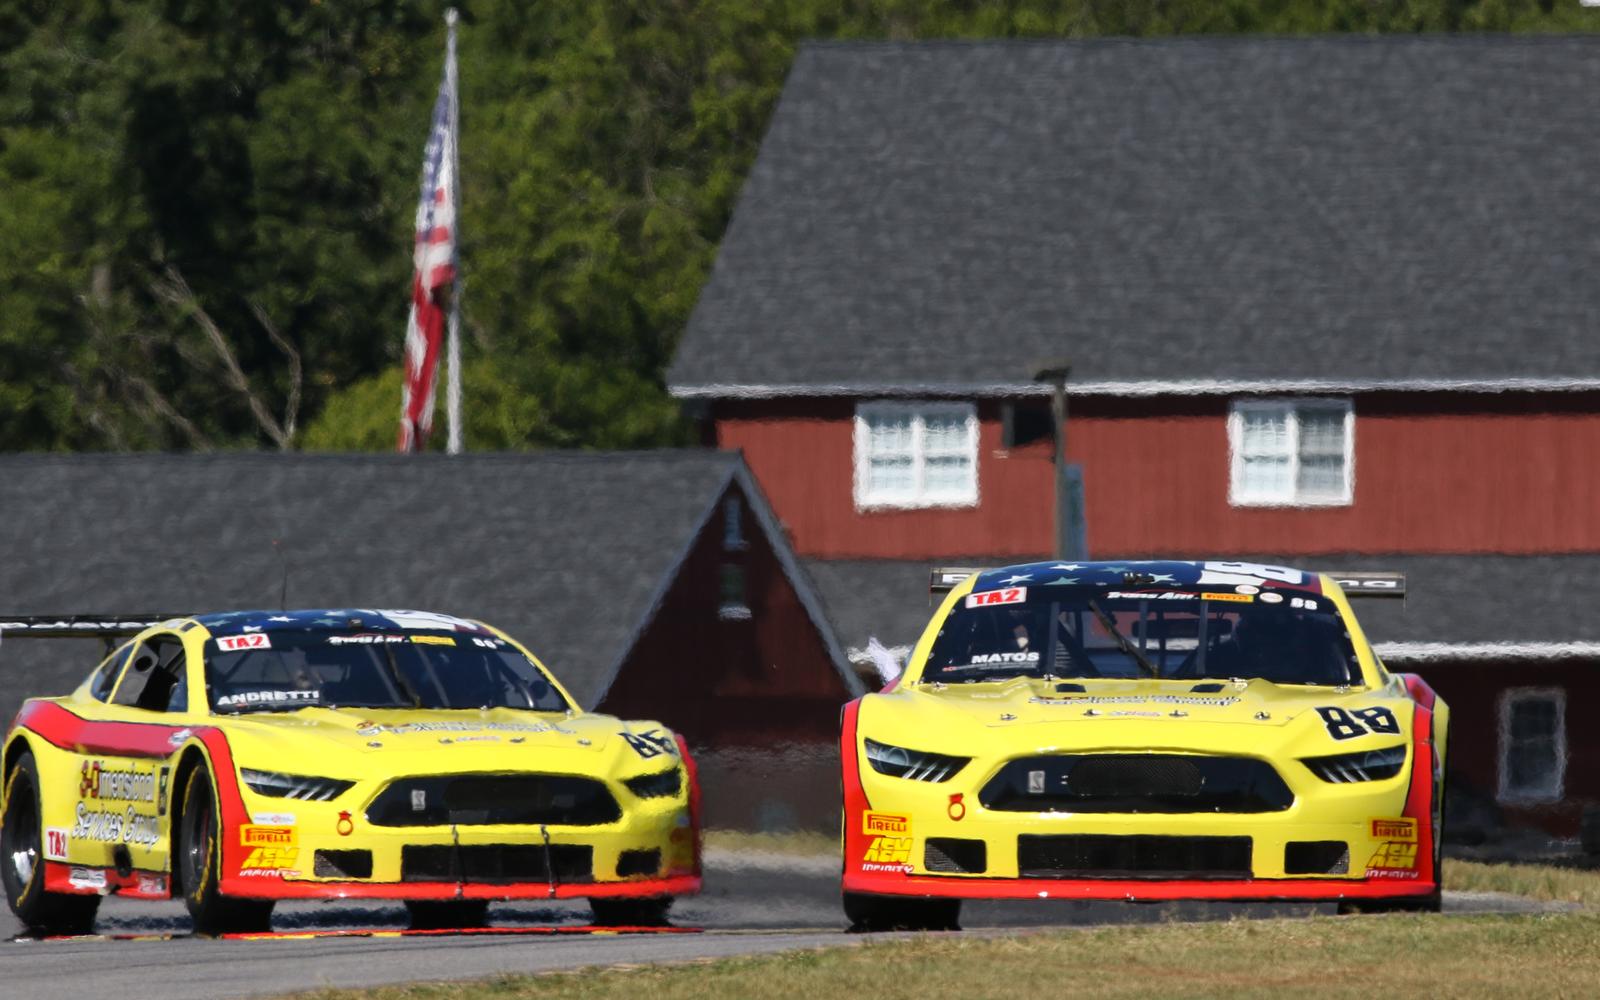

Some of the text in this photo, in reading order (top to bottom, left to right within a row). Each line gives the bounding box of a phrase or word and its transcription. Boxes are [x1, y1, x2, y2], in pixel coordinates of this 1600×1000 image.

[973, 589, 1021, 605] TA2
[1290, 597, 1318, 610] 88
[222, 635, 263, 650] TA2
[971, 652, 1040, 664] MATOS
[217, 690, 320, 706] ANDRETTI
[1314, 705, 1400, 741] 88
[80, 759, 155, 803] 3-Dimensional
[72, 800, 160, 854] Services Group
[867, 814, 907, 832] PIRELLI
[1372, 819, 1413, 838] PIRELLI
[48, 831, 67, 857] TA2
[244, 828, 292, 843] PIRELLI
